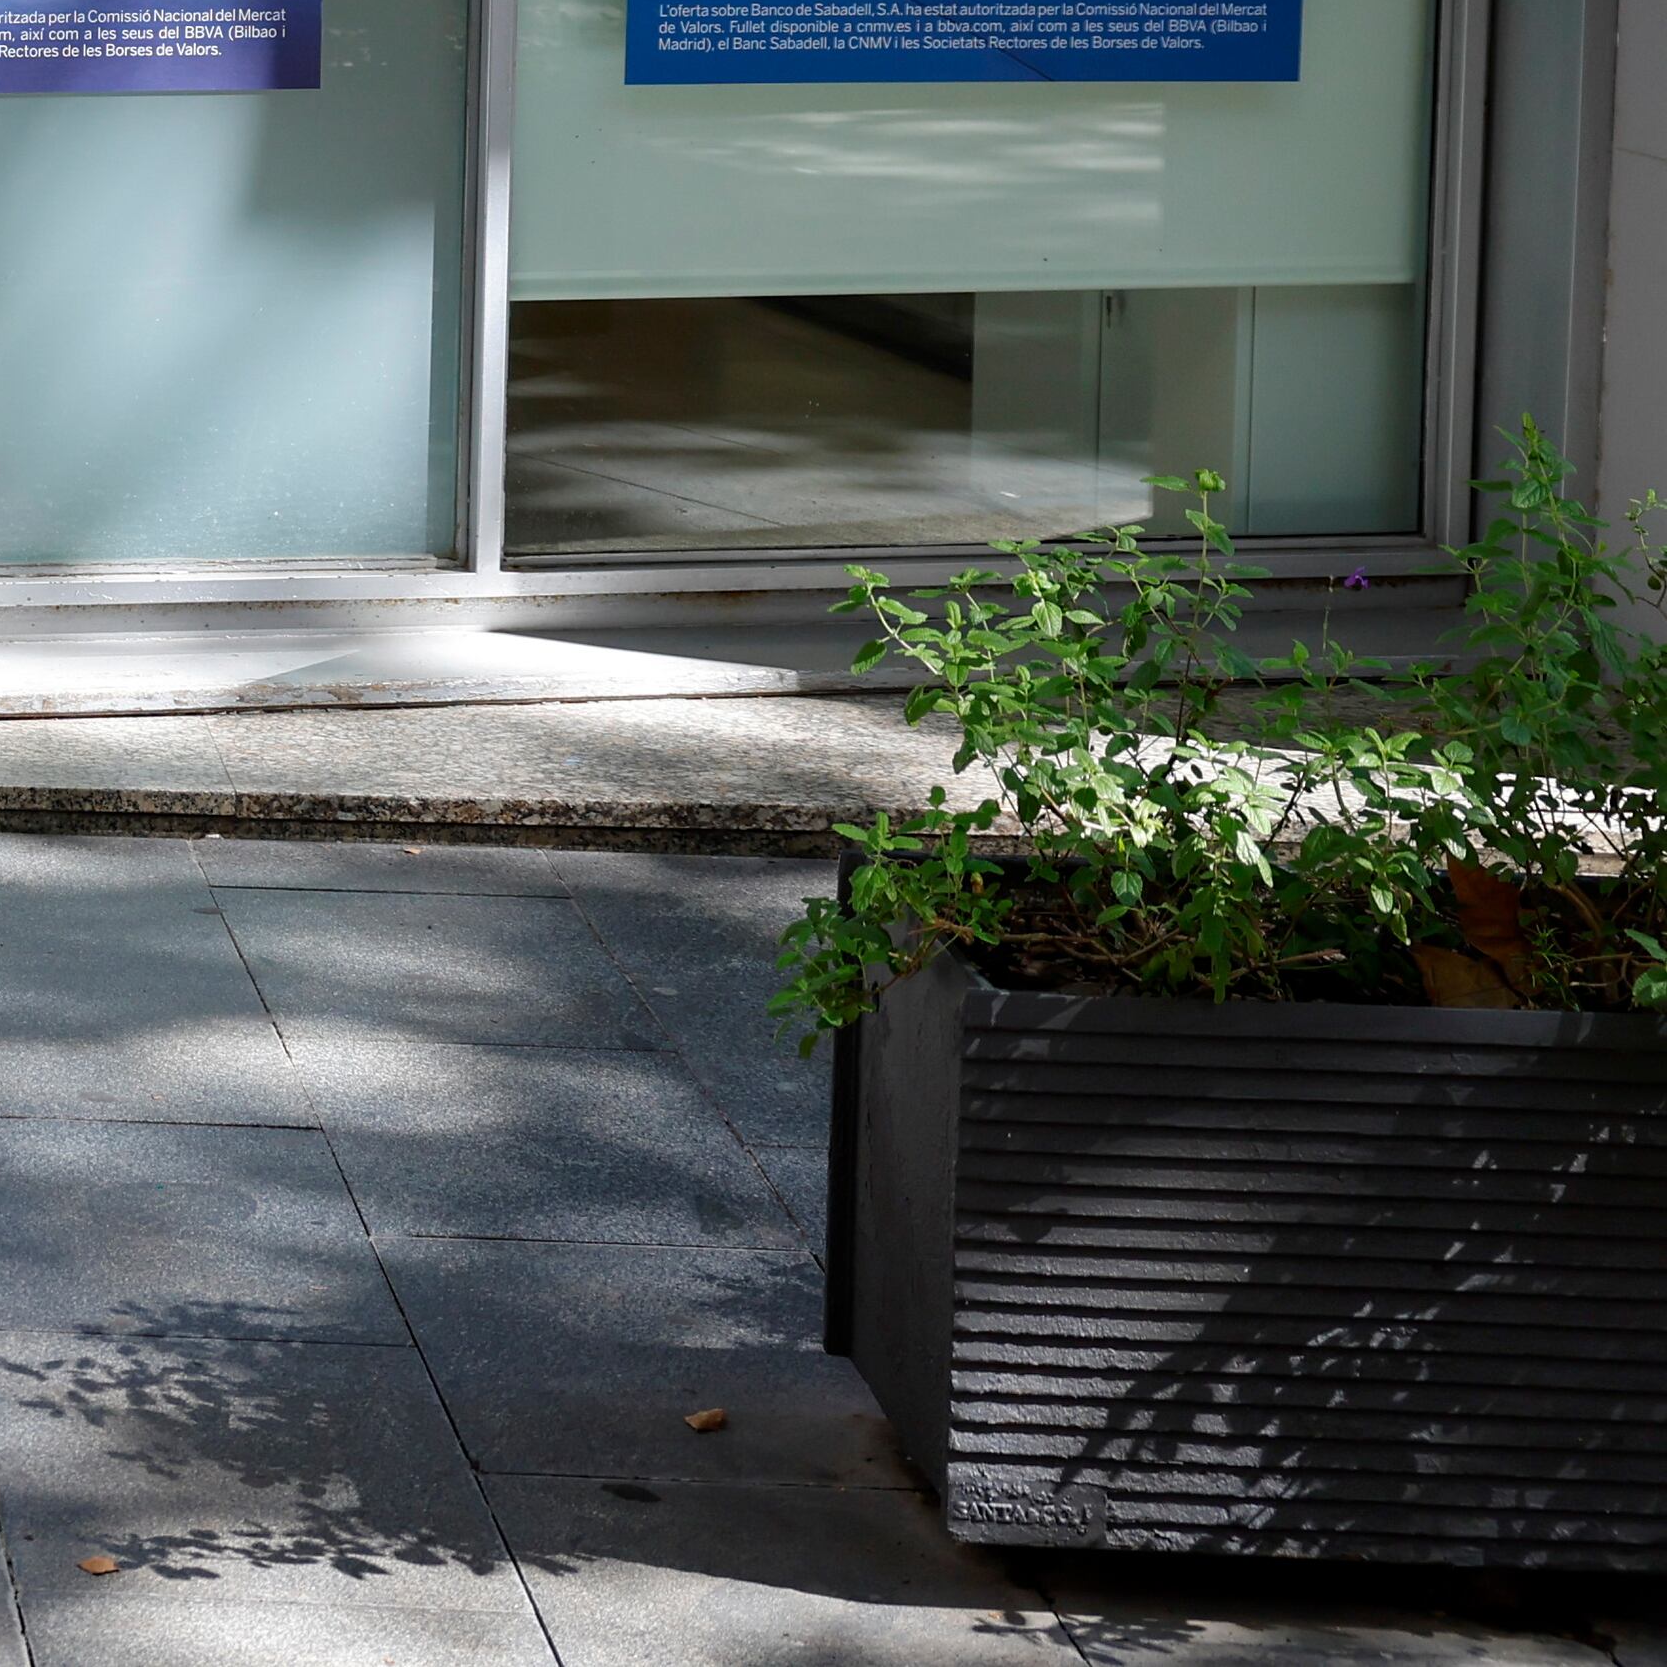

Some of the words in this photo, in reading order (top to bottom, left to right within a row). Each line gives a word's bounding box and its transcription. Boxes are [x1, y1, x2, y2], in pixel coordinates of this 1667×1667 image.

[49, 13, 71, 26] per
[74, 11, 84, 23] la
[88, 10, 151, 23] Comissió
[154, 9, 213, 22] Nacional
[216, 9, 236, 22] del
[239, 9, 285, 21] Mercat
[660, 5, 709, 17] L'oferta
[711, 5, 749, 16] sobre
[751, 3, 793, 16] Banco
[795, 4, 811, 15] de
[815, 3, 874, 16] Sabadell,
[877, 3, 903, 15] S.A.
[906, 3, 921, 15] ha
[924, 4, 957, 15] estat
[959, 3, 1035, 15] autoritzada
[1038, 6, 1060, 17] per
[21, 28, 44, 40] així
[49, 30, 78, 41] com
[84, 30, 91, 41] a
[98, 27, 116, 40] les
[122, 29, 153, 39] seus
[159, 27, 179, 39] del
[184, 26, 223, 39] BBVA
[229, 25, 277, 41] (Bilbao
[0, 45, 59, 57] Rectores
[63, 45, 79, 57] de
[83, 44, 102, 57] les
[106, 44, 153, 56] Borses
[156, 43, 173, 55] de
[177, 43, 221, 55] Valors.
